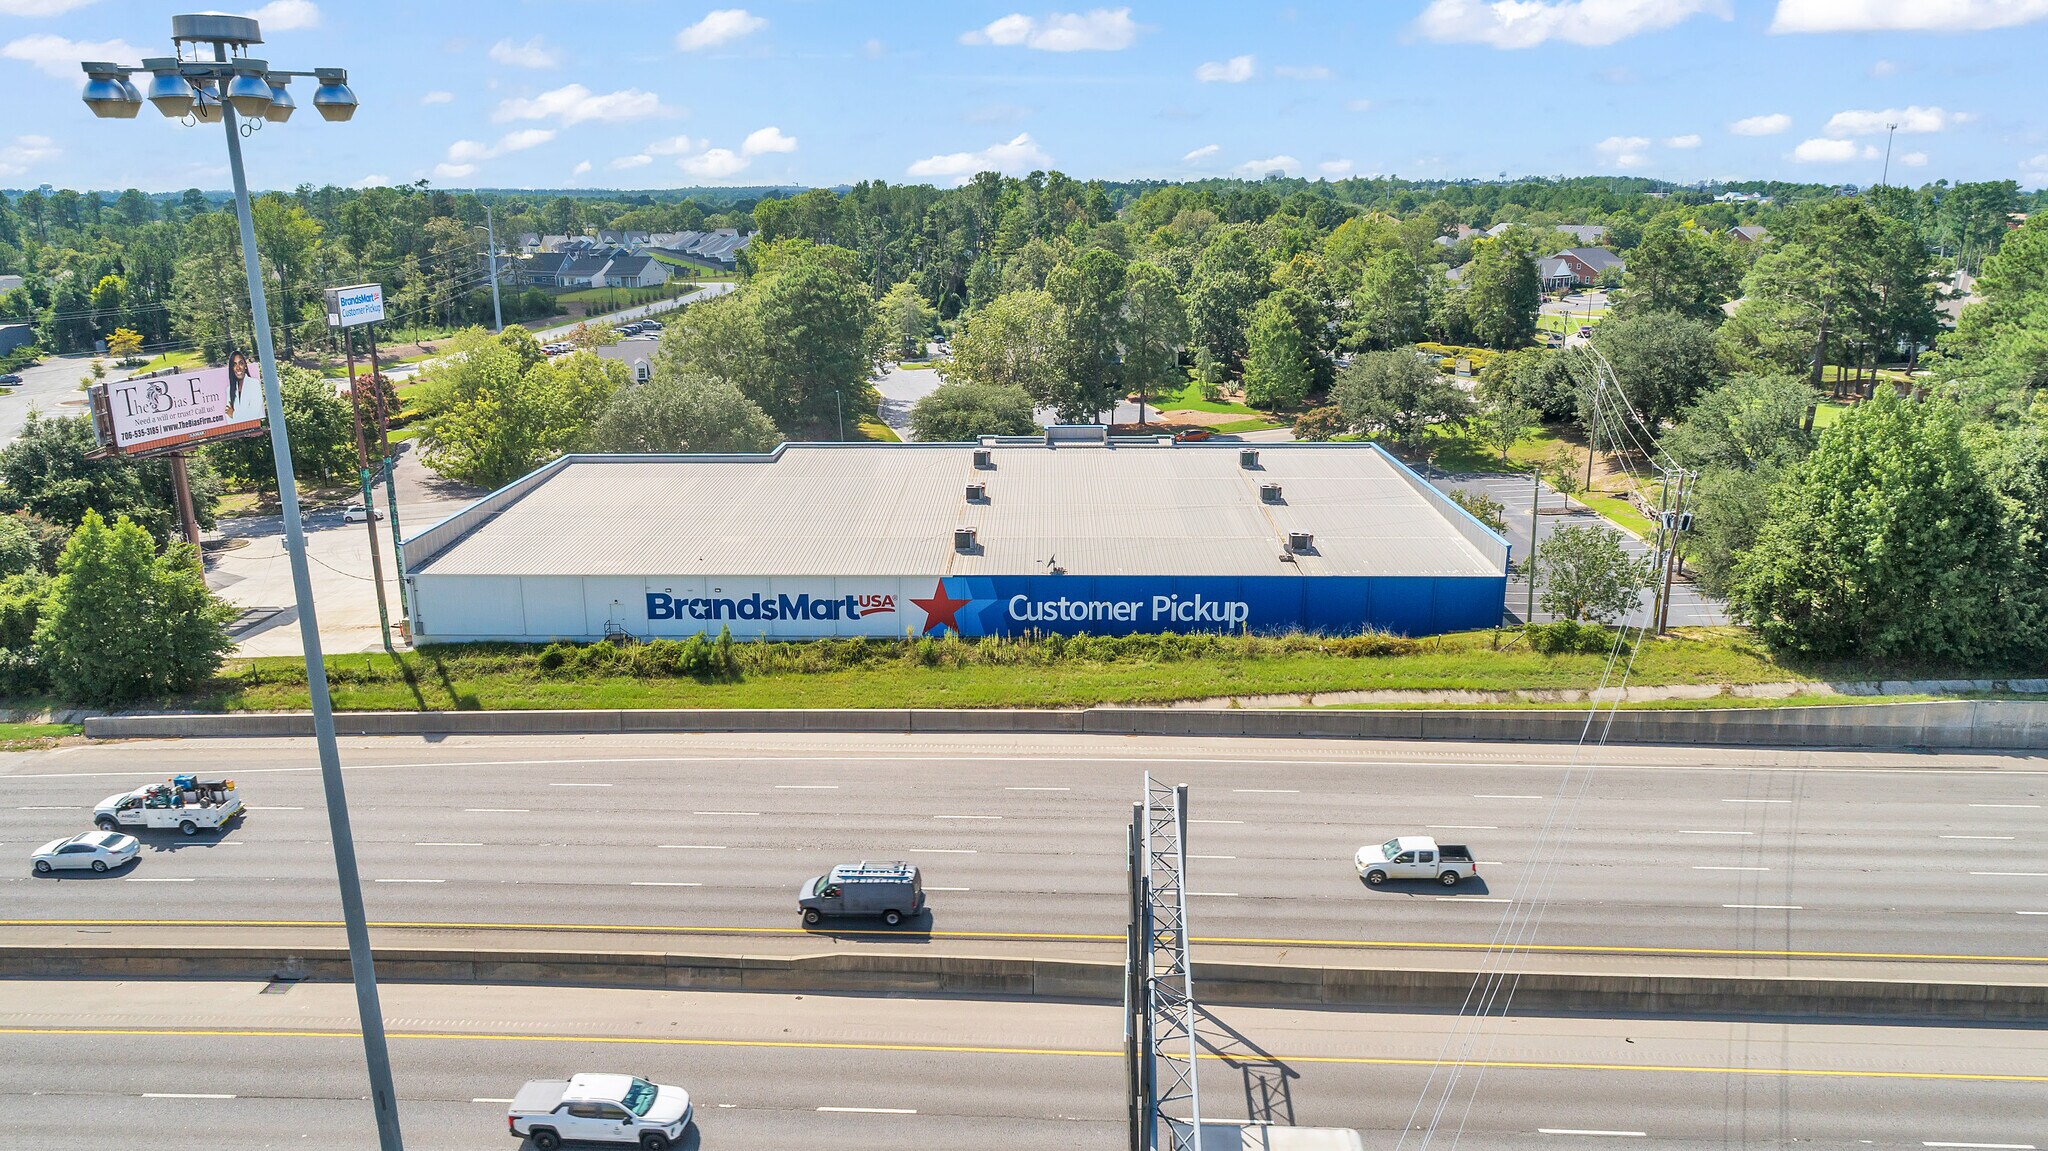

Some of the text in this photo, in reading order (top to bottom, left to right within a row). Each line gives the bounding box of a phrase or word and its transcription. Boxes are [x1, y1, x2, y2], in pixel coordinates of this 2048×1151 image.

[340, 294, 374, 306] BrandsMart
[342, 304, 381, 317] Customer Pickup
[116, 377, 220, 417] The Bias Firm
[134, 416, 151, 426] Need
[156, 414, 169, 422] will
[177, 410, 194, 418] trust?
[194, 407, 206, 415] Call
[206, 405, 215, 413] us!
[163, 415, 224, 432] www.TheBiasFirm.com
[646, 592, 861, 620] BrandsMart
[1008, 594, 1249, 628] Customer Pickup
